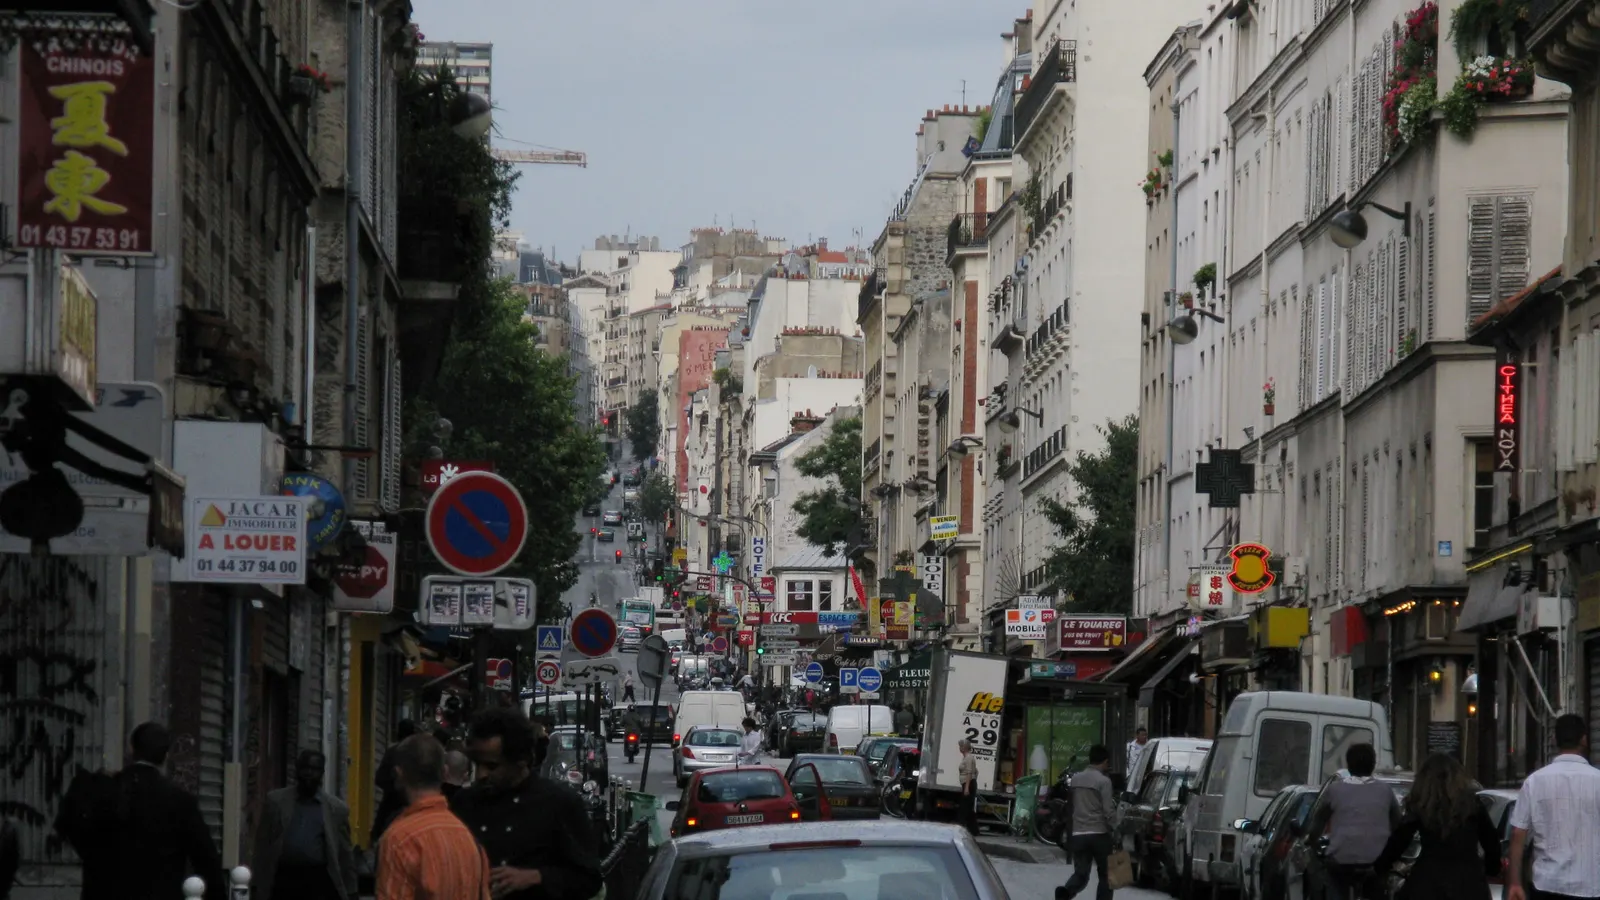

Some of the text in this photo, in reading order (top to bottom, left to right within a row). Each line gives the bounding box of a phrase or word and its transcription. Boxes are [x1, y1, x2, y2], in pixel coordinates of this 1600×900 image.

[46, 57, 125, 76] CHINOIS
[21, 224, 138, 249] 01 43 57 53 91
[1498, 365, 1516, 470] CITHEA NOVA
[284, 476, 321, 490] ANK
[227, 502, 297, 518] JACAR
[228, 519, 297, 530] IMMOBILIER
[198, 533, 297, 552] A LOUER
[197, 559, 297, 574] 01 44 37 94 00
[770, 612, 793, 623] KFC
[819, 614, 846, 622] ESPACE
[1064, 620, 1123, 630] LE TOUAREG
[541, 668, 555, 679] 30
[844, 672, 853, 684] P
[889, 680, 899, 688] 01
[900, 679, 909, 687] 43
[911, 679, 921, 687] 57
[963, 716, 971, 726] A
[964, 727, 998, 746] 29
